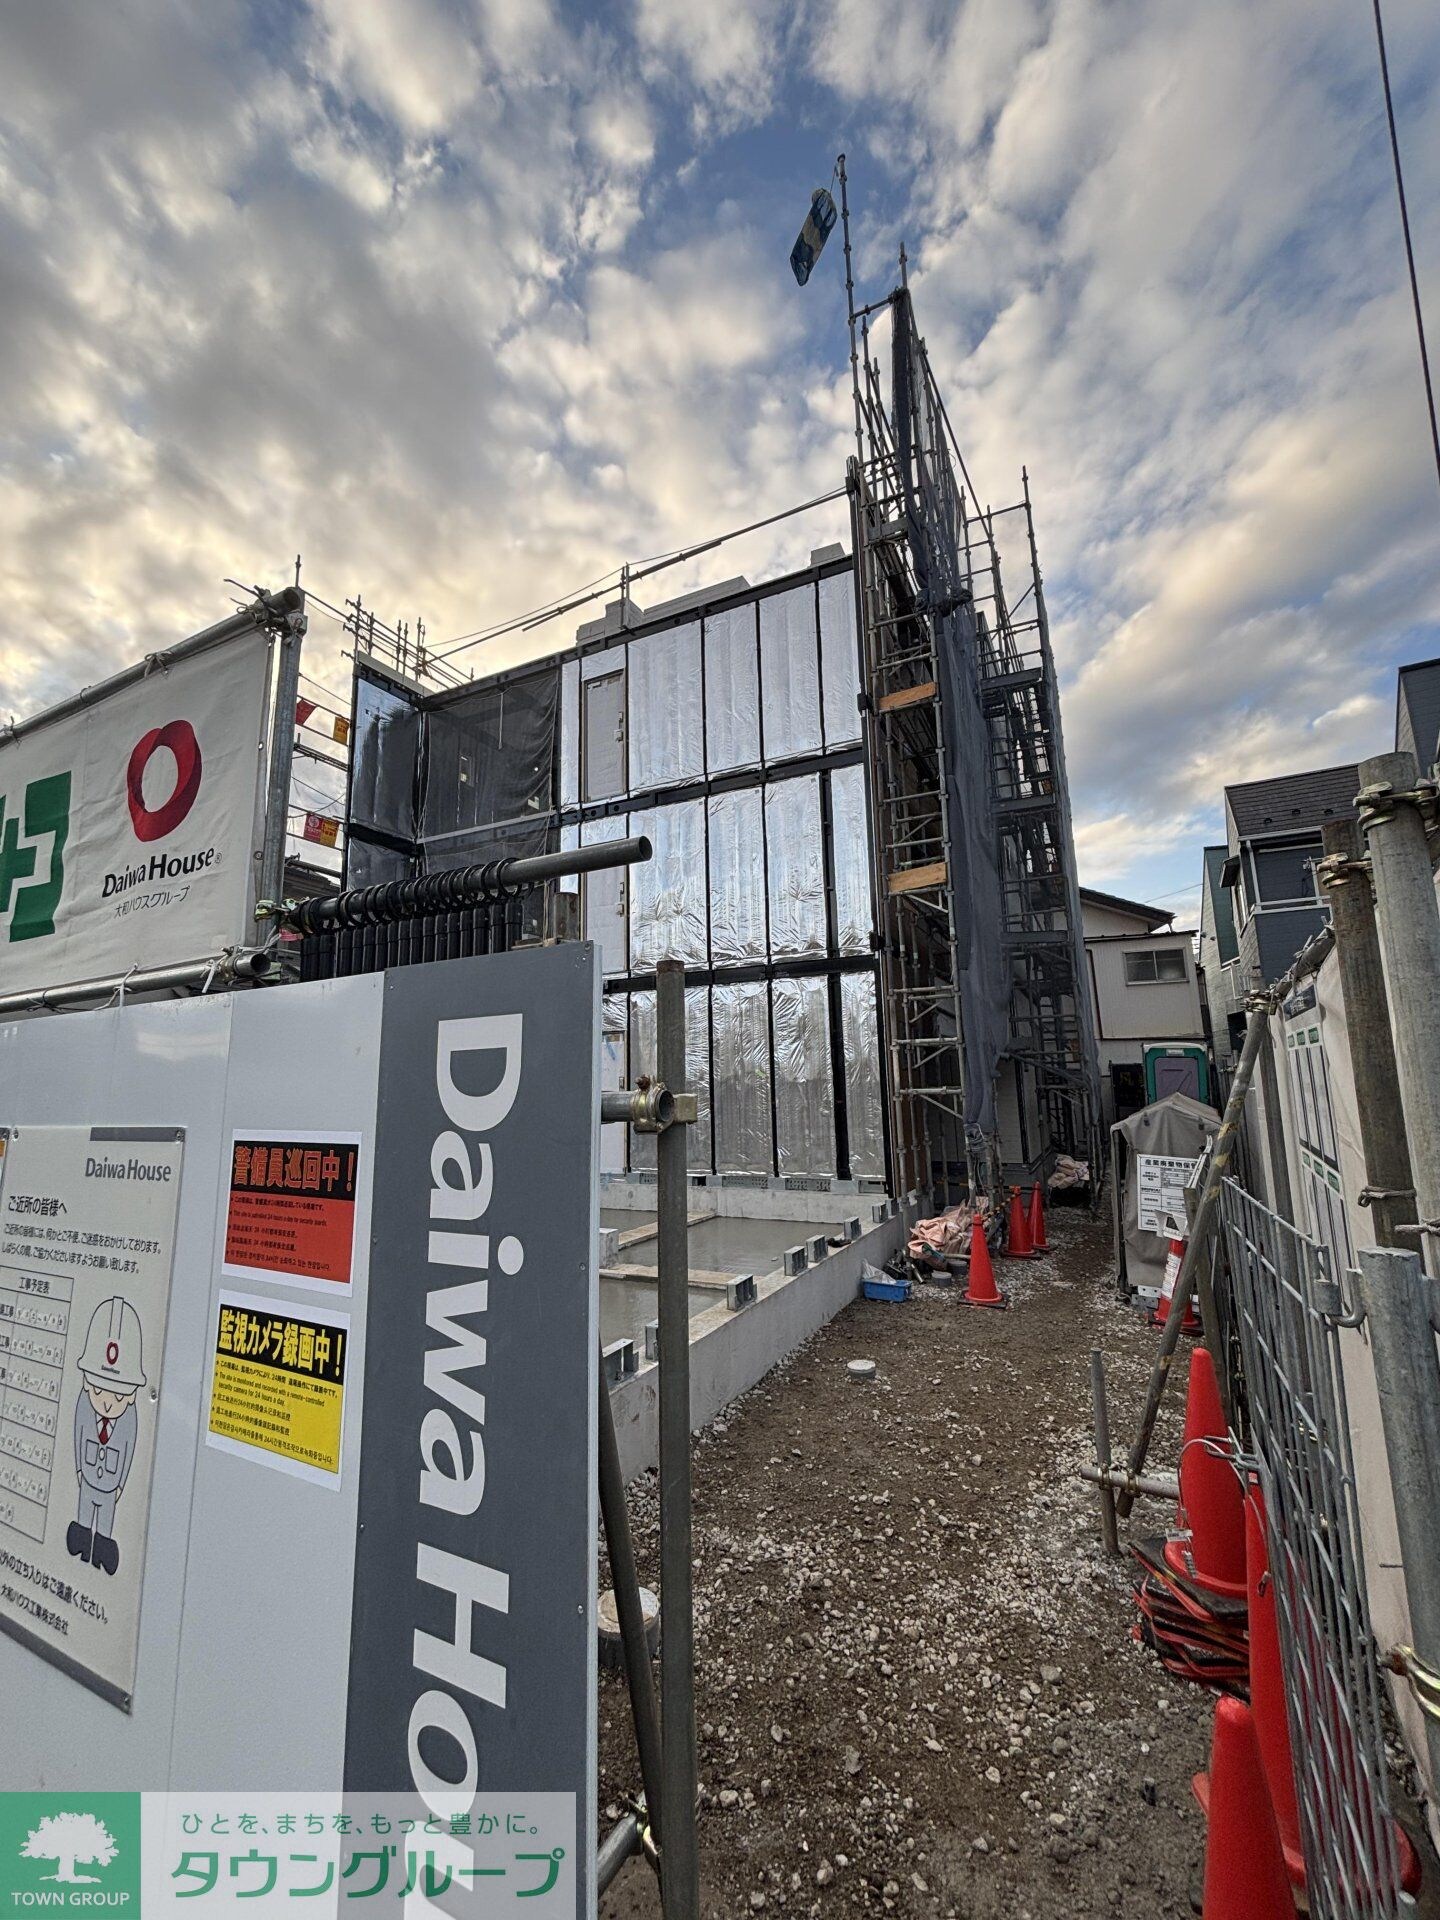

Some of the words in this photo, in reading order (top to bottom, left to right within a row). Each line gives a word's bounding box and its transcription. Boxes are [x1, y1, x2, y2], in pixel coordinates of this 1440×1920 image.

[102, 864, 146, 898] Daiwa
[149, 847, 214, 880] House
[114, 885, 190, 918] 大和ハウスグループ
[85, 1157, 125, 1179] Daiwa
[127, 1159, 171, 1182] House
[8, 1195, 68, 1217] ご近所の皆様へ
[419, 1013, 524, 1516] Daiwa
[18, 1277, 50, 1294] 工事予定表
[219, 1310, 342, 1377] 監視カメラ録画中!
